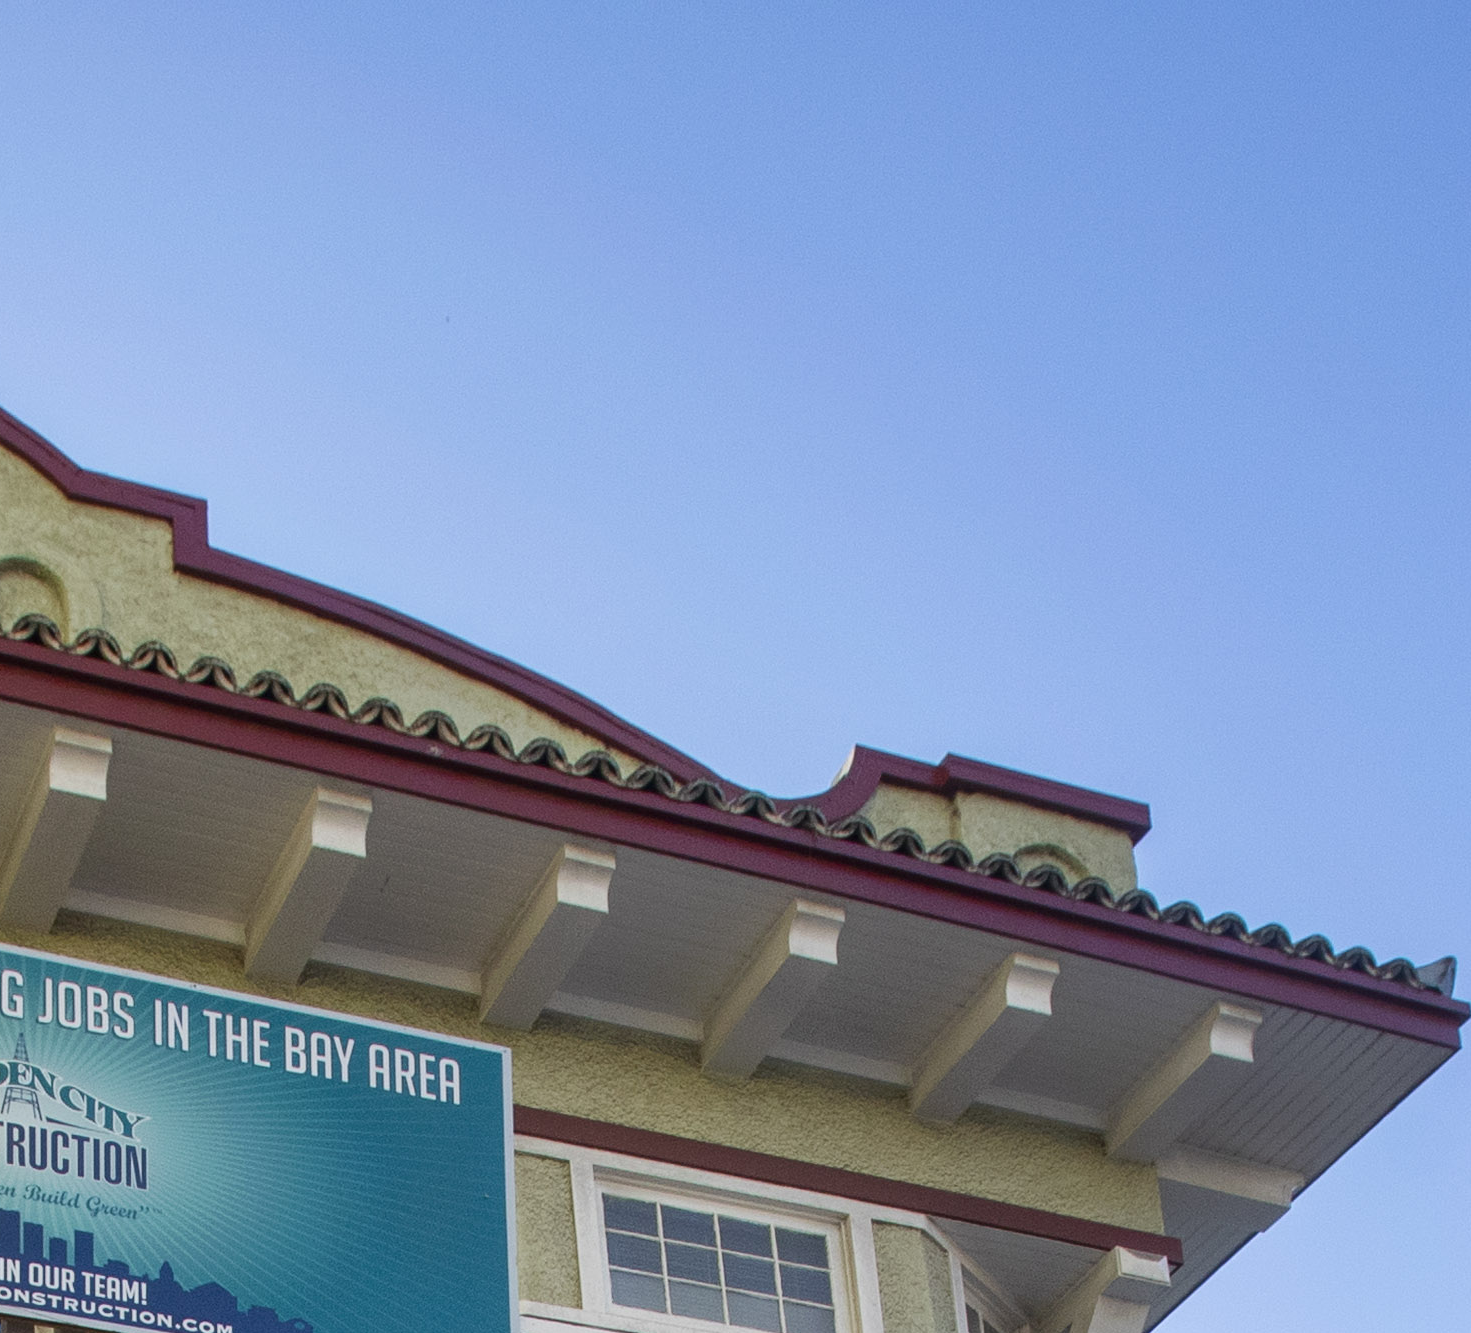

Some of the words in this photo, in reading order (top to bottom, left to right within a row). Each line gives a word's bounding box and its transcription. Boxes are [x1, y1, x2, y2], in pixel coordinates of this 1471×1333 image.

[38, 977, 135, 1039] JOBS
[154, 998, 189, 1051] IN
[203, 1009, 270, 1068] THE
[284, 1025, 354, 1083] BAY
[369, 1043, 460, 1105] AREA
[59, 1085, 148, 1139] CITY
[23, 1185, 80, 1209] Build
[28, 1262, 75, 1294] OUR
[82, 1271, 148, 1306] TEAM!
